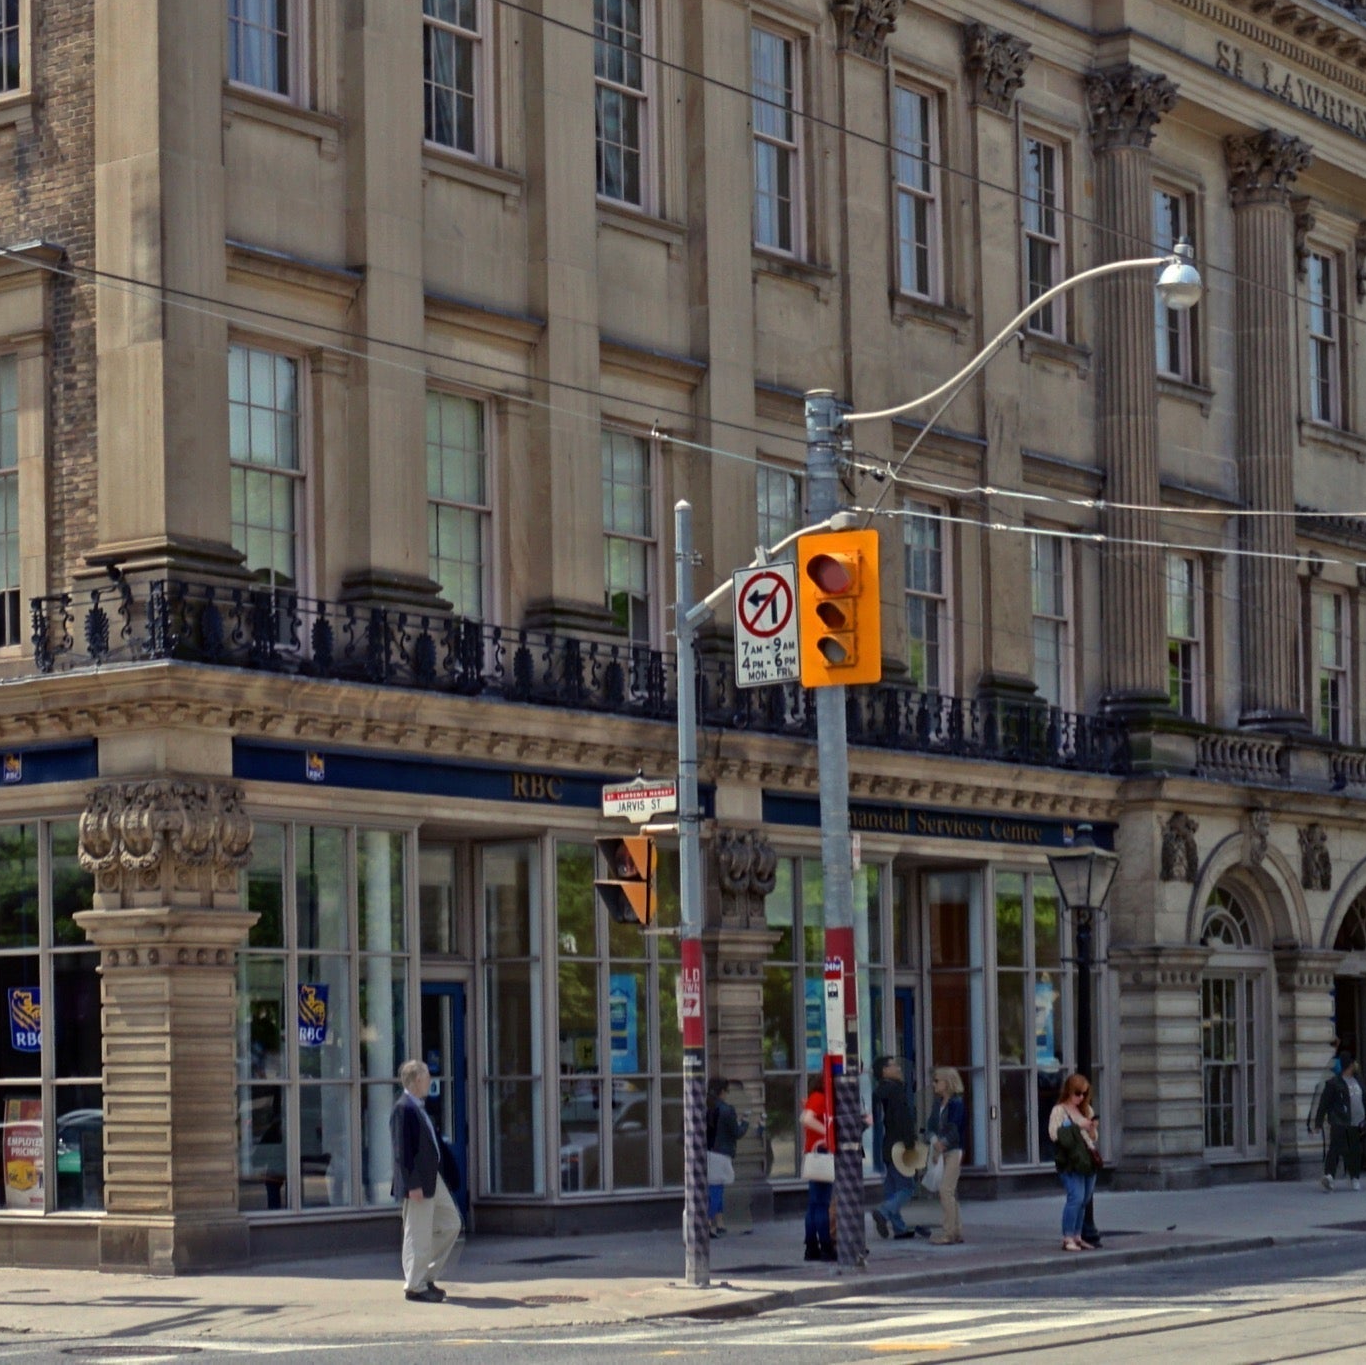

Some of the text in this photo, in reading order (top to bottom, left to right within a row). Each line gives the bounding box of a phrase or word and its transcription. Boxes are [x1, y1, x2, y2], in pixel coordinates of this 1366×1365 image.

[748, 670, 767, 680] MON
[511, 772, 563, 800] RBC
[617, 799, 662, 813] JARVIS ST
[848, 807, 1043, 843] nancial Services Centre
[299, 1027, 323, 1041] RBC
[10, 1146, 40, 1156] PRICING
